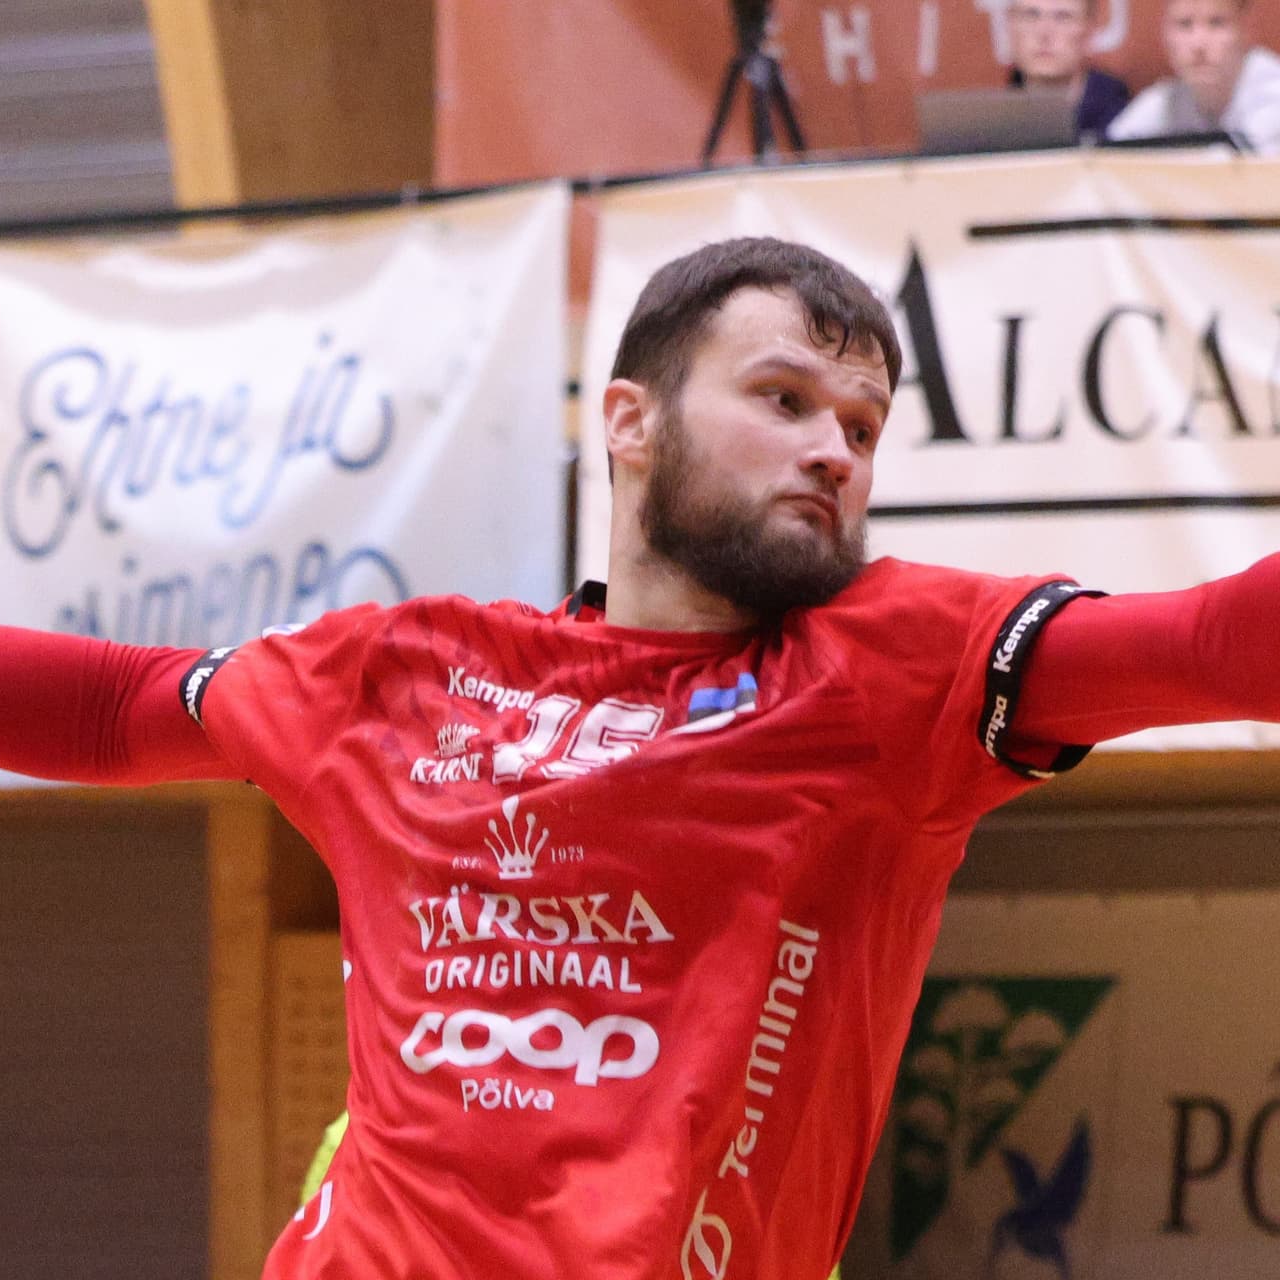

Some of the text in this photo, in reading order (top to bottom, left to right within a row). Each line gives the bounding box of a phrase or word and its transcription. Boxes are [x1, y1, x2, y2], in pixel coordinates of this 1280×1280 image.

[992, 597, 1070, 674] Kempa
[447, 665, 535, 714] Kempa
[491, 693, 666, 785] 15
[408, 882, 675, 952] VÄRSKA
[424, 950, 642, 994] ORIGINAAL
[399, 1007, 660, 1088] coop
[460, 1077, 556, 1113] Põlva
